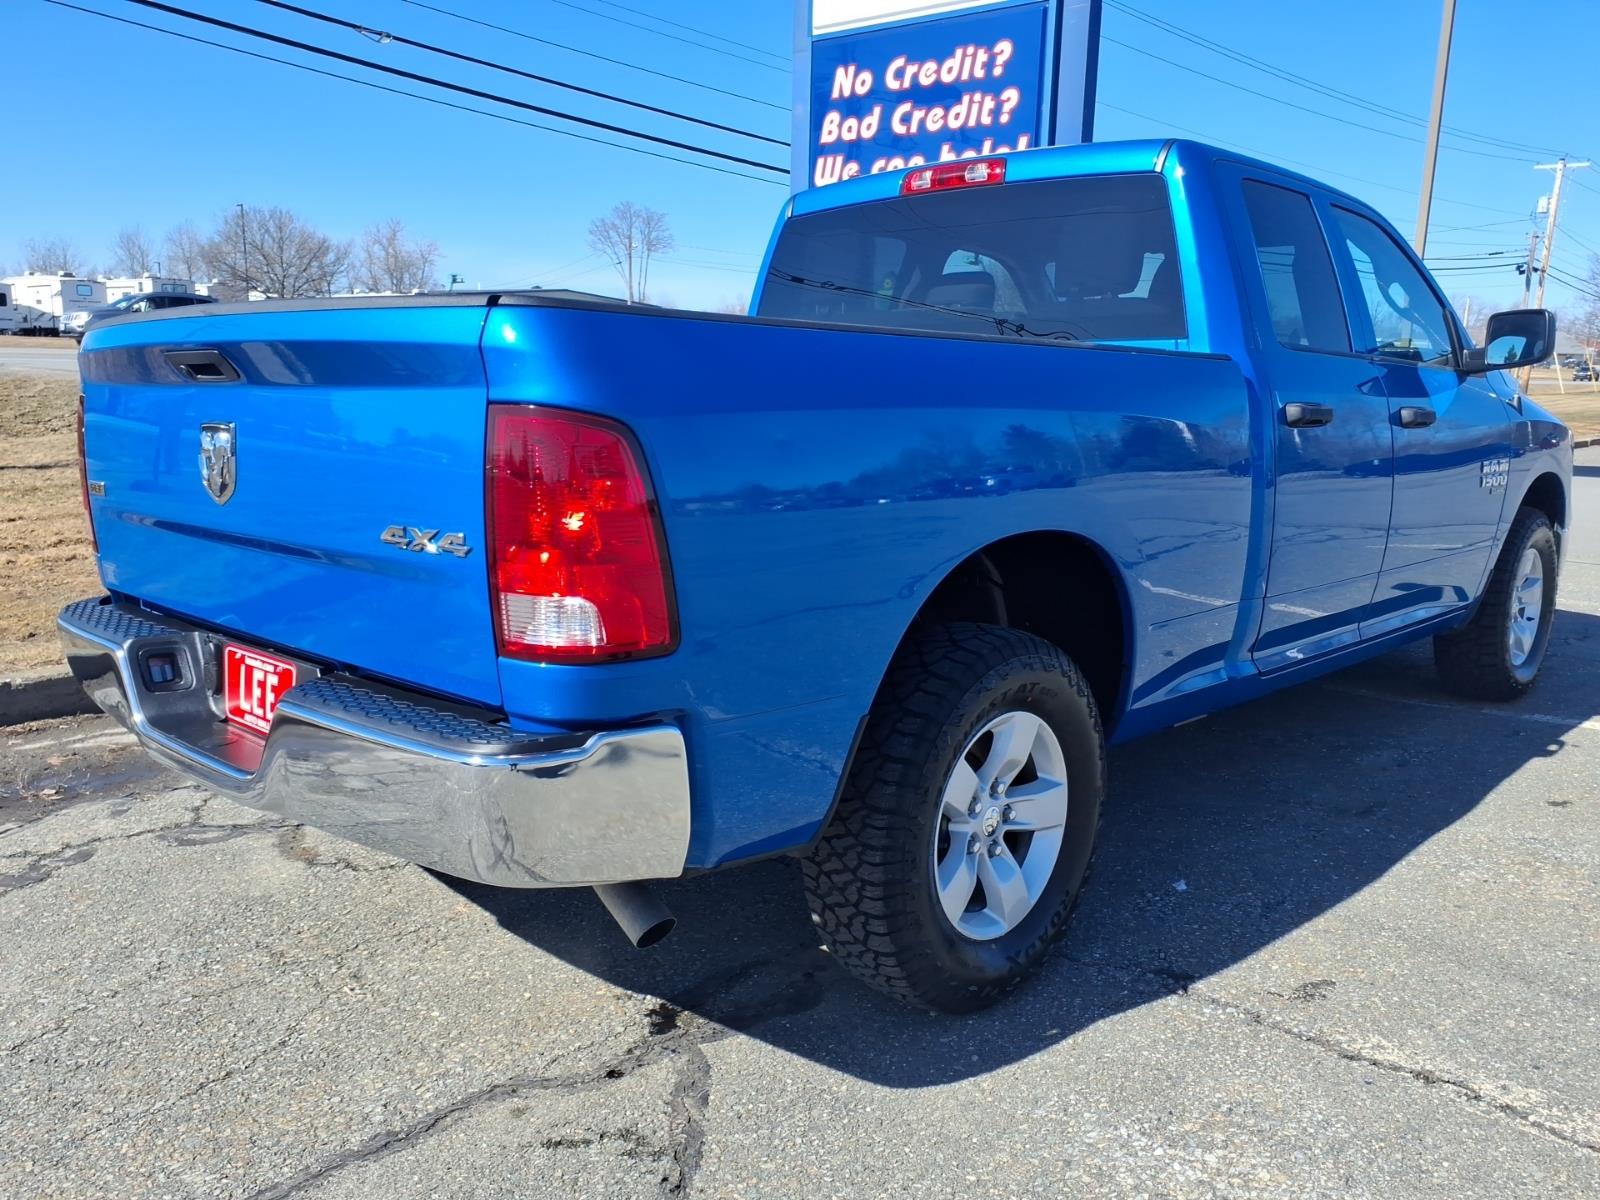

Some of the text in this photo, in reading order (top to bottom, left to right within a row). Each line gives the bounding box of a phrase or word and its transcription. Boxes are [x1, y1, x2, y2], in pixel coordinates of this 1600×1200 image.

[831, 39, 1013, 99] No Credit?
[820, 86, 1020, 144] Bad Credit?
[814, 153, 860, 188] We
[239, 663, 280, 721] LEE
